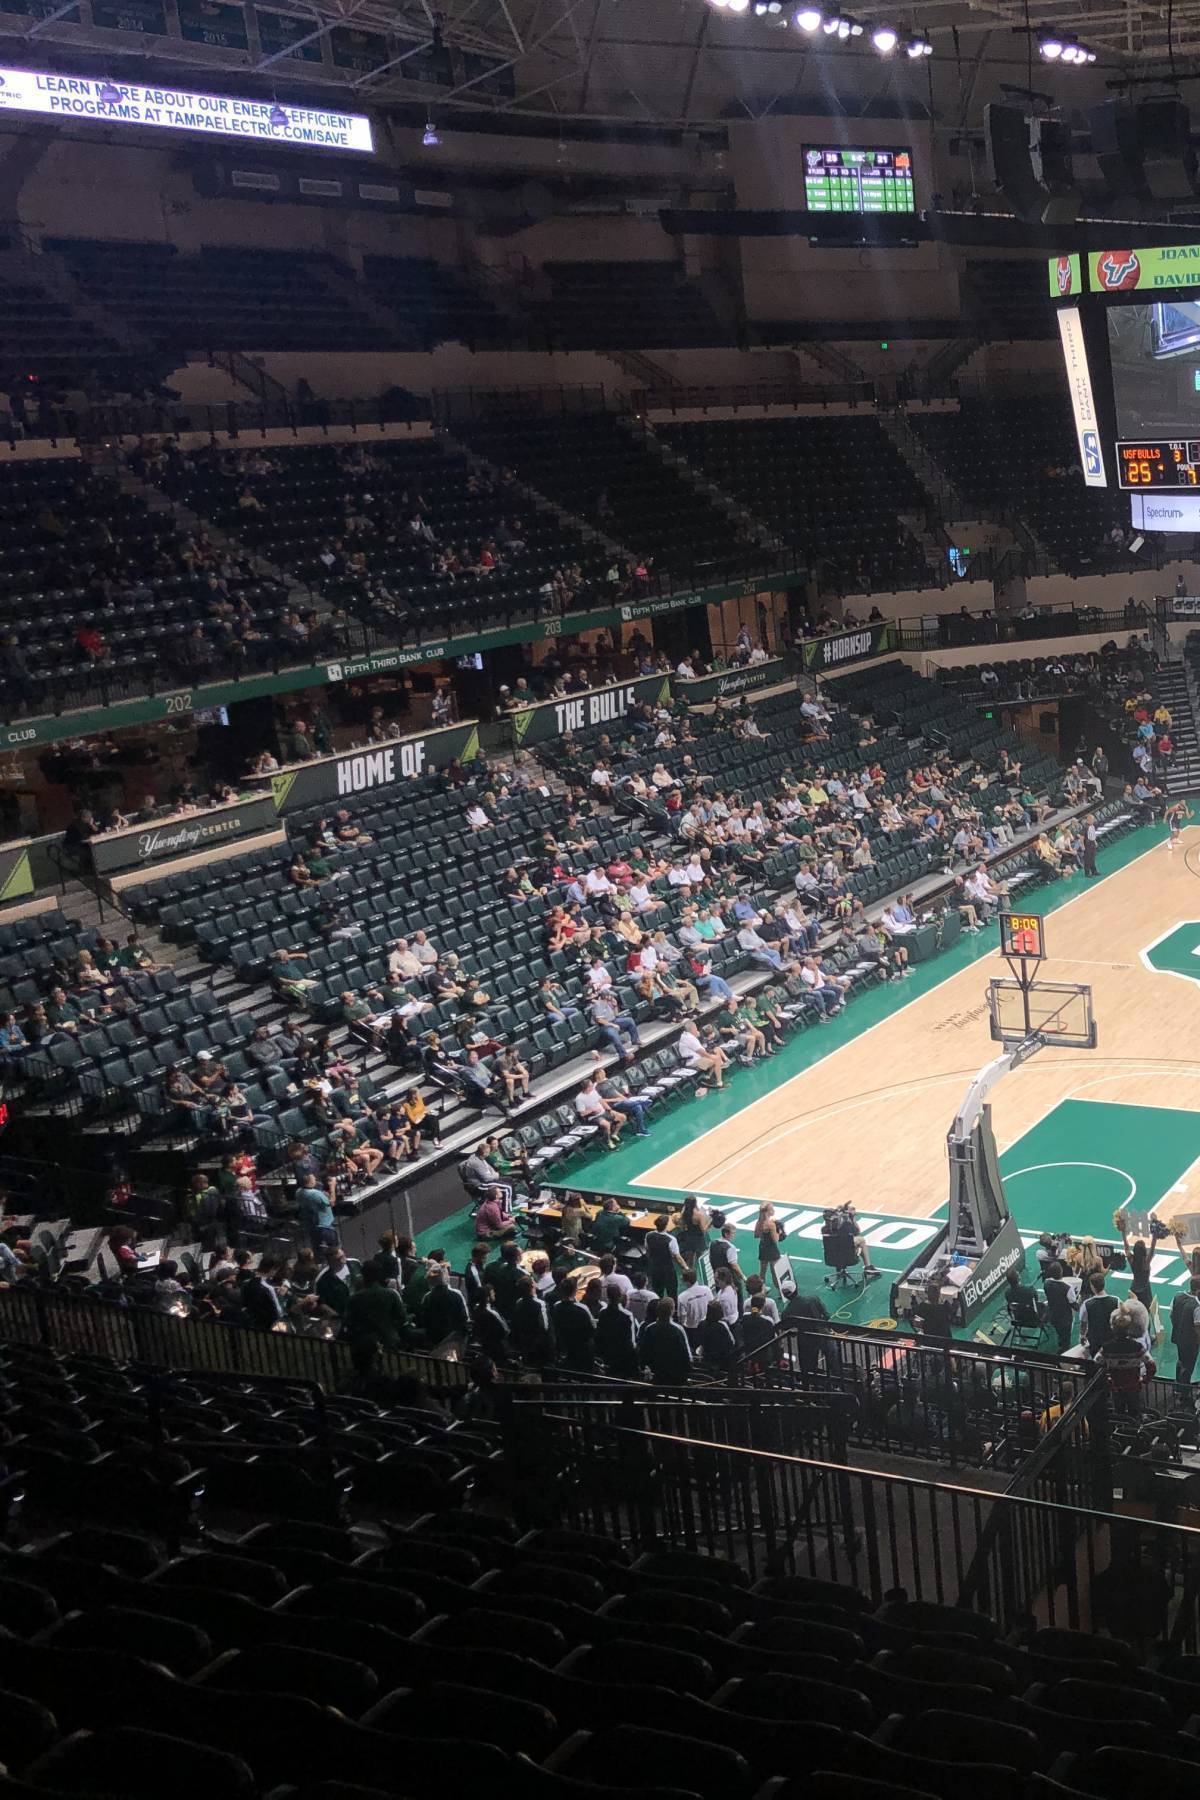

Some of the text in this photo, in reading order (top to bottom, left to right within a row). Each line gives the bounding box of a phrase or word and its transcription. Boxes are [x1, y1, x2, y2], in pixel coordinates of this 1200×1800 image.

[36, 76, 91, 95] LEARN
[144, 90, 194, 108] ABOUT
[198, 97, 229, 113] OUR
[50, 96, 140, 120] PROGRAMS
[144, 108, 162, 121] AT
[1154, 272, 1200, 287] DAVID
[1173, 450, 1181, 462] 3
[1128, 462, 1151, 482] 25
[1147, 506, 1181, 519] Spectrum
[544, 621, 562, 636] 203
[823, 631, 872, 663] #HORNSUP
[344, 647, 445, 676] FIFTH THIRD BANK CLUB
[166, 695, 193, 714] 202
[555, 699, 585, 734] THE
[8, 728, 37, 742] CLUB
[337, 741, 426, 795] HOME OF
[138, 818, 241, 858] Yuengling CENTER
[1012, 917, 1039, 930] 8:09
[976, 1247, 1021, 1296] CenterState
